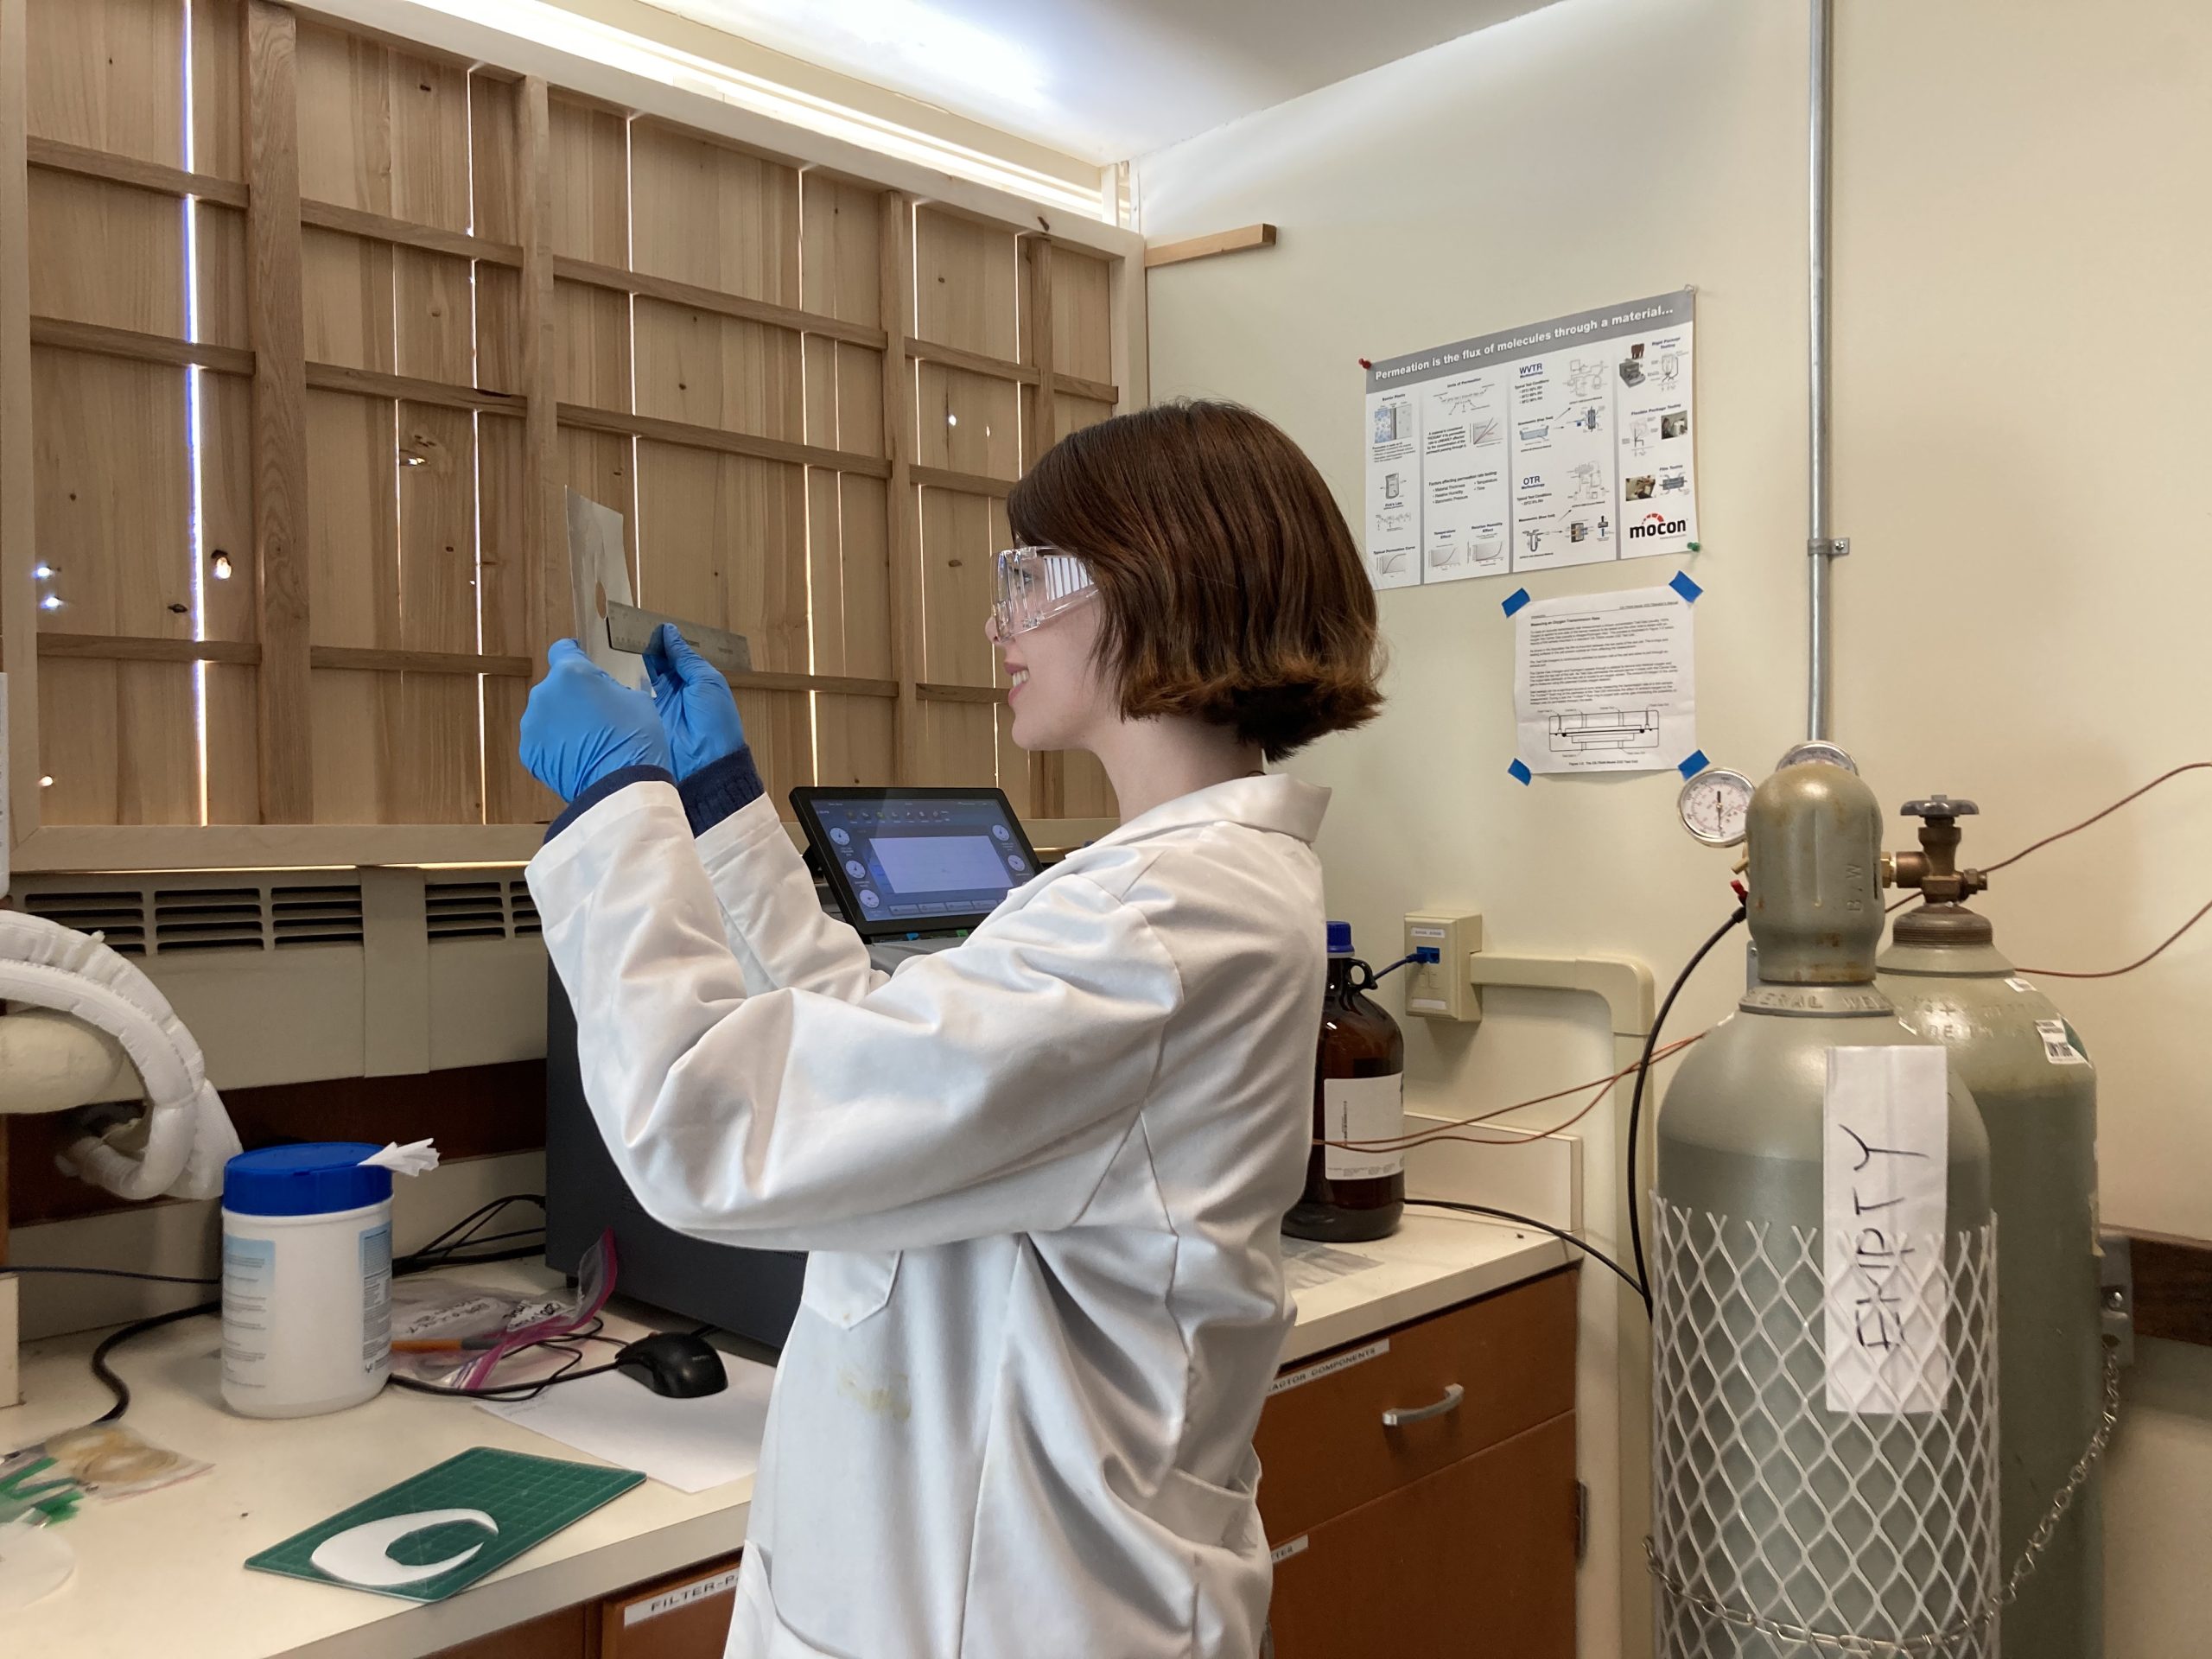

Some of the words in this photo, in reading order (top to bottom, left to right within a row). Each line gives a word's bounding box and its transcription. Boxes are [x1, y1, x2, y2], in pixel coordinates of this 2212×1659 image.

[1375, 359, 1429, 380] Permeation
[1432, 357, 1441, 367] is
[1444, 353, 1460, 365] the
[1462, 348, 1481, 359] flux
[1484, 343, 1495, 354] of
[1497, 331, 1551, 352] molecules
[1554, 321, 1598, 338] through
[1611, 306, 1674, 326] material...
[1519, 363, 1542, 374] WVTR
[1523, 476, 1541, 485] OTR
[1630, 519, 1687, 538] mocon
[1839, 1124, 1929, 1351] EMPTY
[1268, 1373, 1306, 1392] ACTOR
[651, 1574, 740, 1612] FILTER-P
